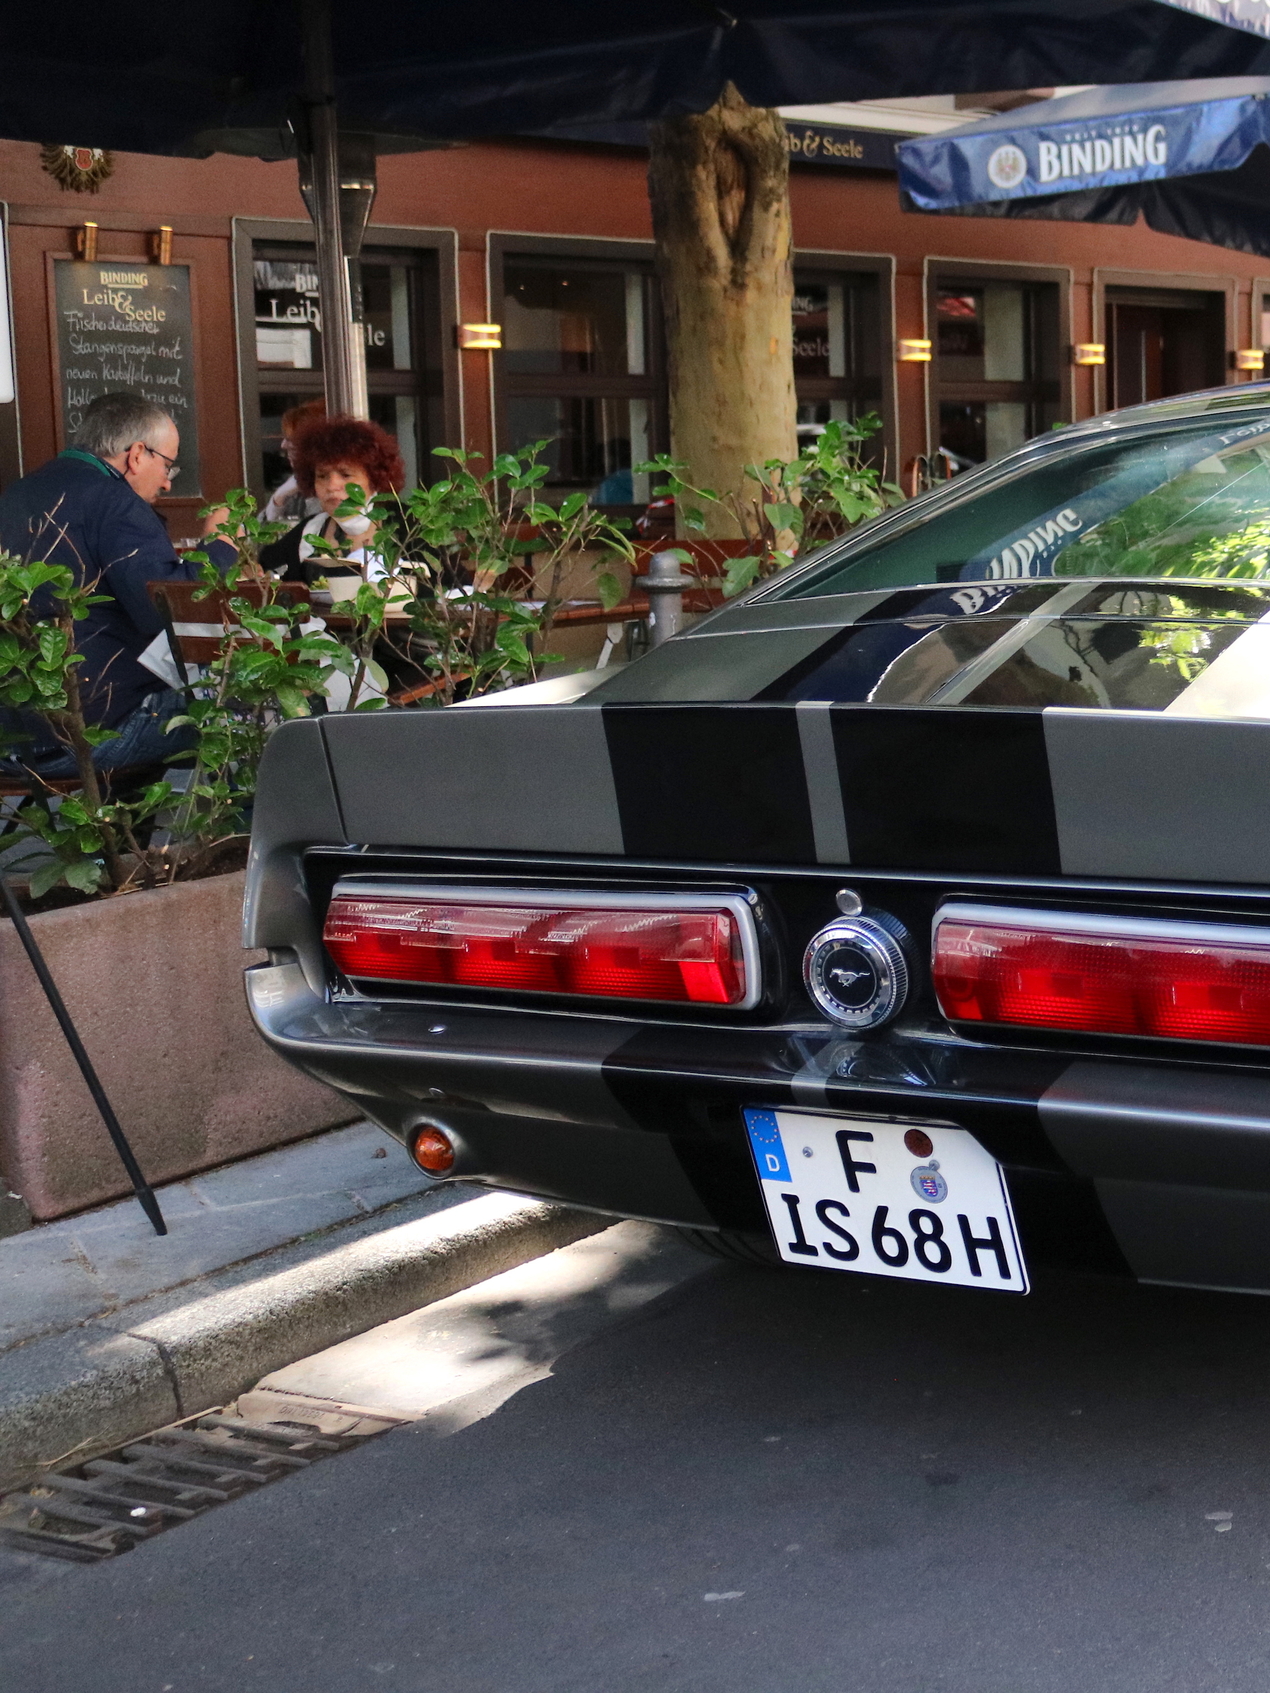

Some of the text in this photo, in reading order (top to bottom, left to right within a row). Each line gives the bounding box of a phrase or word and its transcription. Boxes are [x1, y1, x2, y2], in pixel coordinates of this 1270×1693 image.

[823, 136, 864, 159] Seele
[1038, 124, 1167, 183] BINDING
[100, 270, 148, 287] BINDING
[82, 288, 117, 306] Leib
[125, 305, 166, 321] Seele
[764, 1153, 781, 1173] D
[835, 1129, 877, 1194] F
